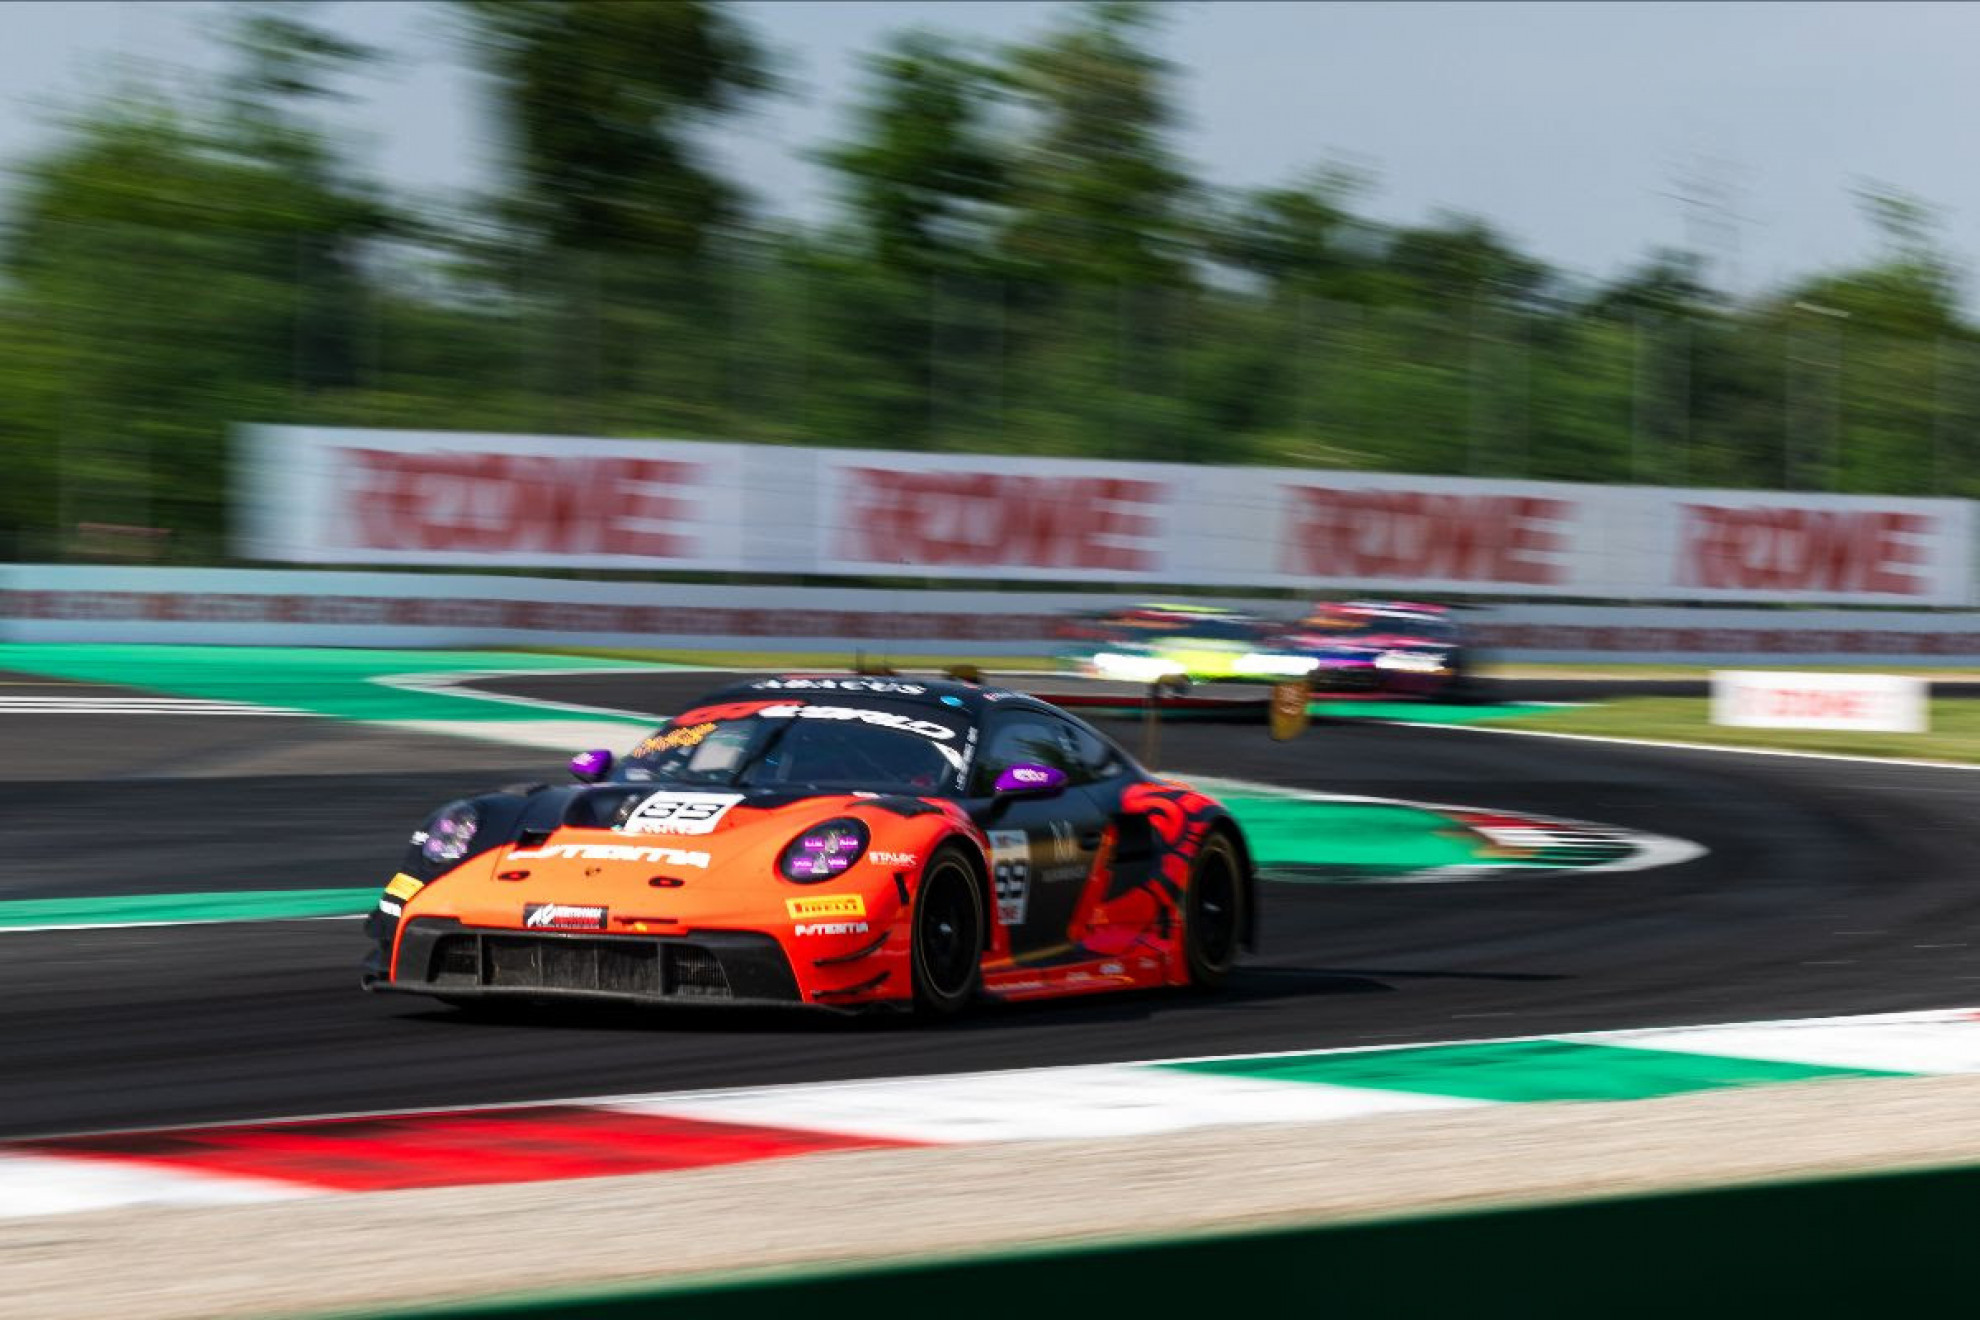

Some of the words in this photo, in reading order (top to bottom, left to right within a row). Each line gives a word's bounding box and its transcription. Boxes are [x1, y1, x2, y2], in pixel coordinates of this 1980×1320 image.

[336, 447, 704, 559] ROWE
[838, 466, 1168, 572] ROWE
[1280, 484, 1572, 586] ROWE
[1675, 503, 1933, 595] ROWE
[995, 859, 1027, 899] 99
